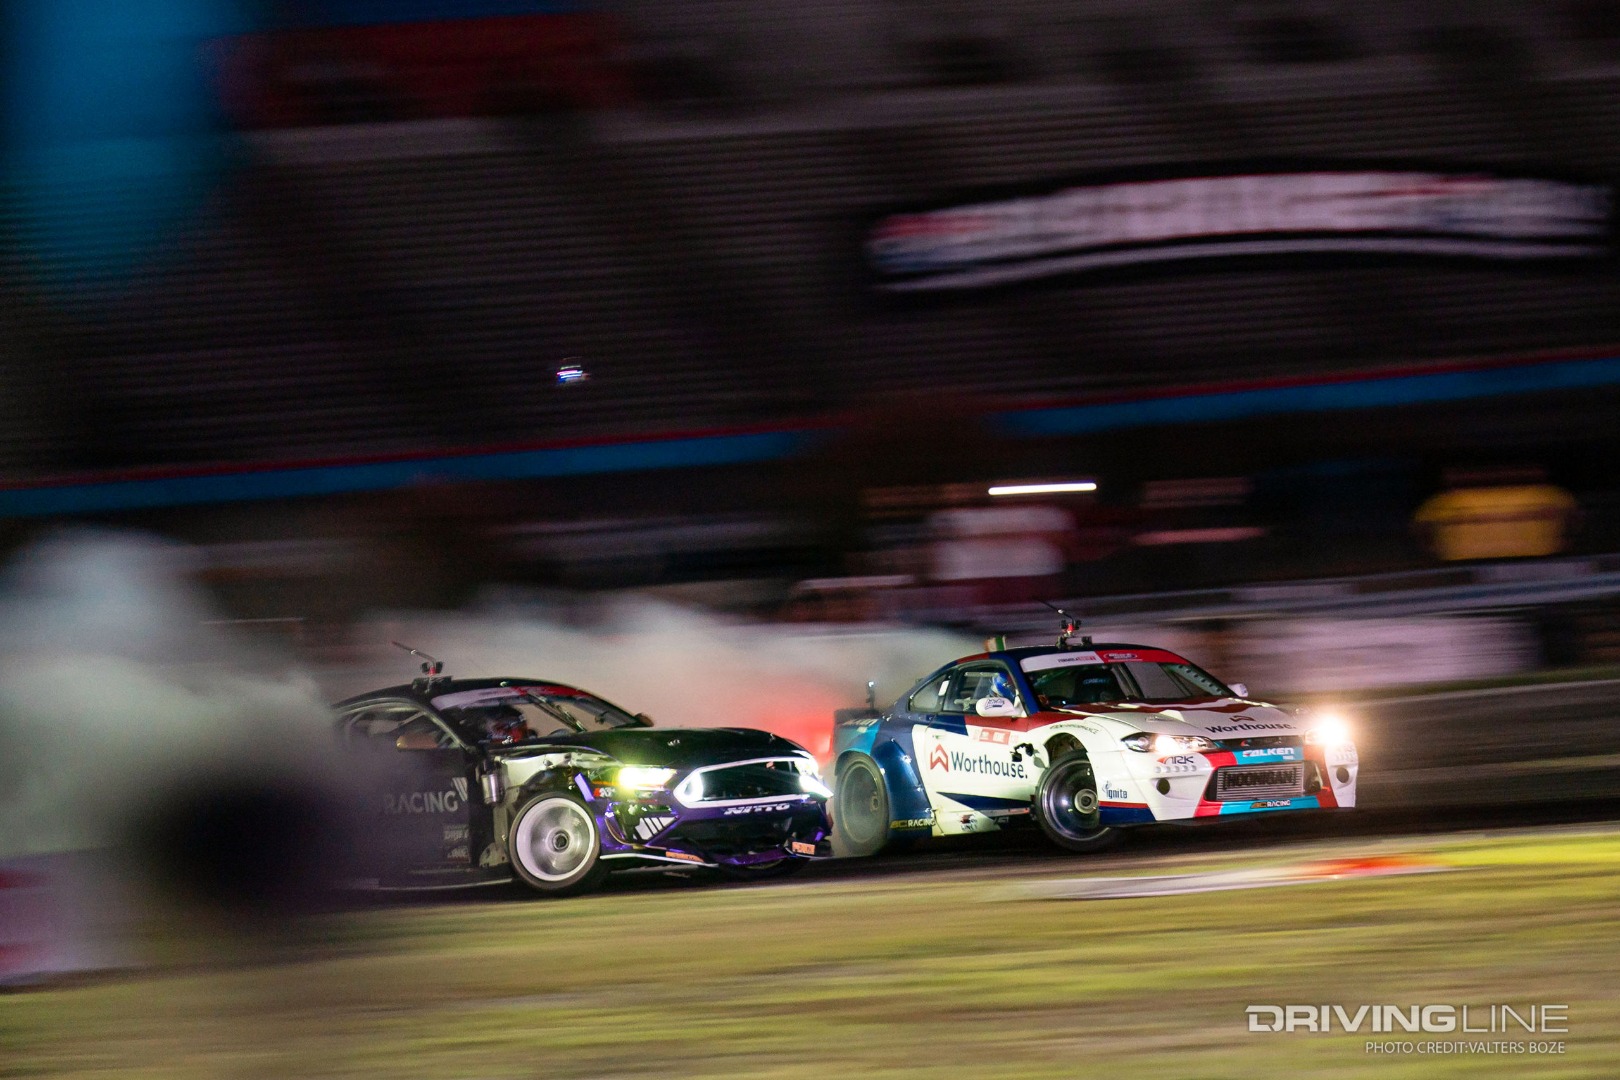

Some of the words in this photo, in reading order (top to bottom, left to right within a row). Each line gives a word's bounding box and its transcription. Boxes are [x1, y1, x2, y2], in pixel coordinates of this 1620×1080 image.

[1242, 747, 1294, 758] FALKEN
[950, 750, 1028, 779] Worthouse.
[384, 790, 459, 814] RACING
[1267, 800, 1291, 808] RACING
[724, 803, 790, 815] NITTO
[908, 818, 936, 827] RACING
